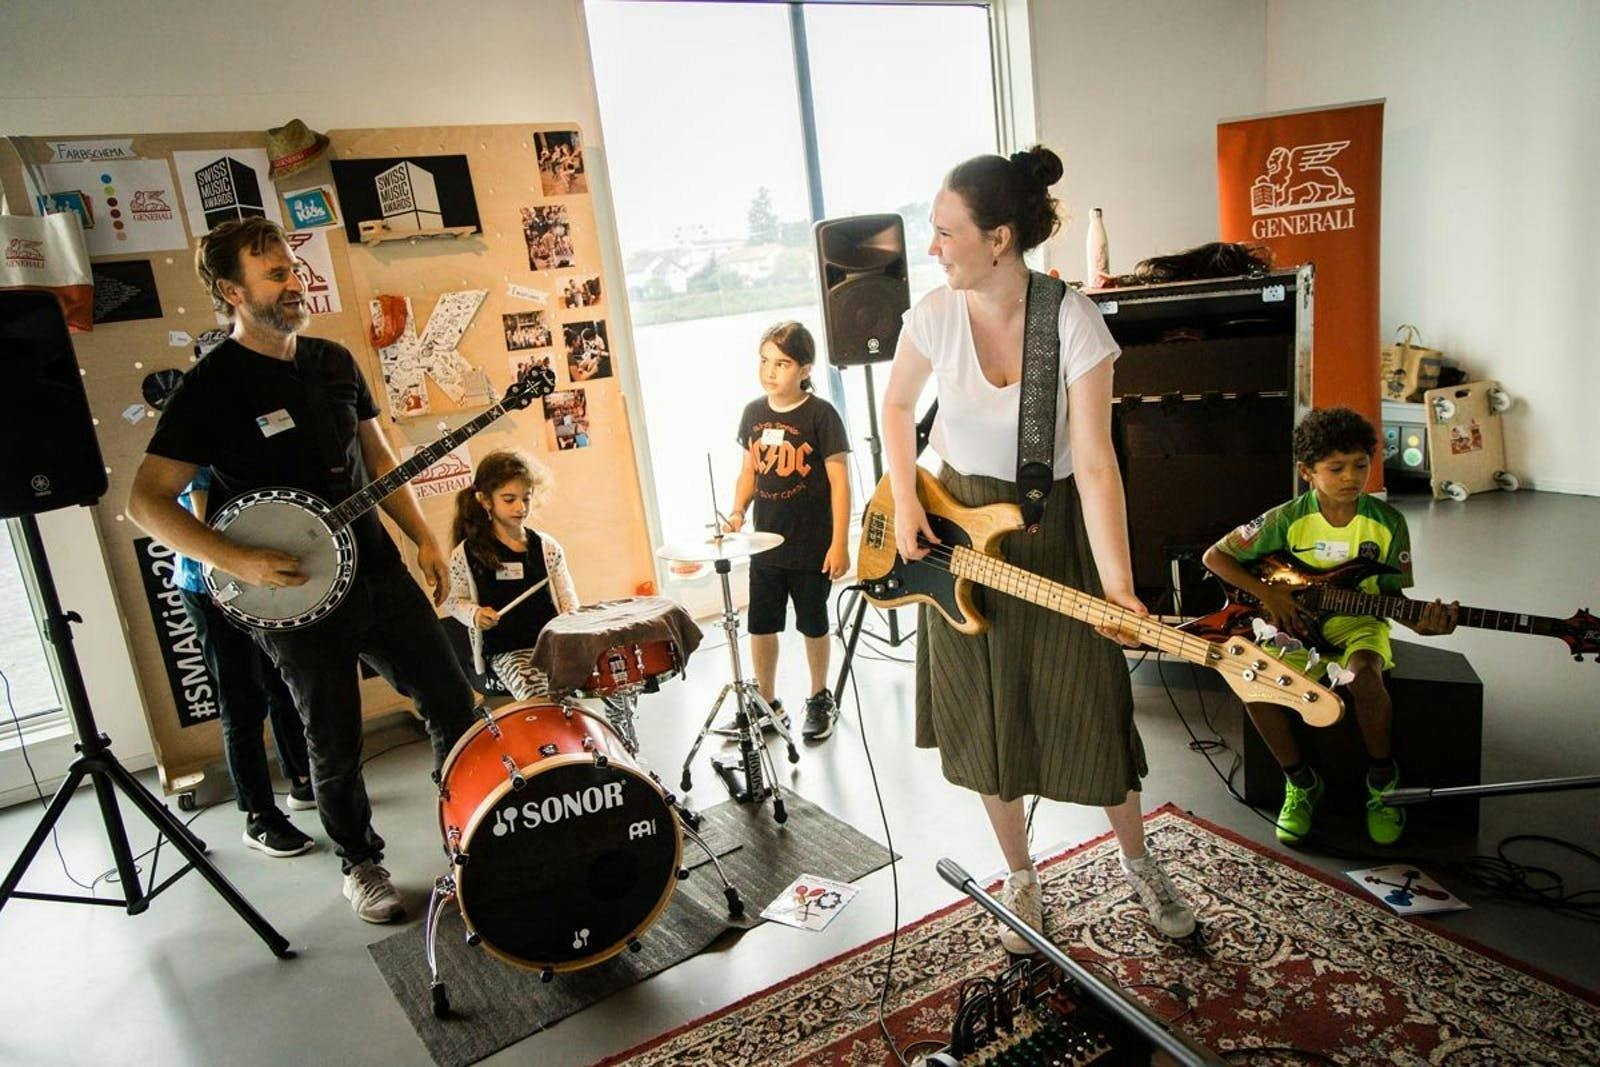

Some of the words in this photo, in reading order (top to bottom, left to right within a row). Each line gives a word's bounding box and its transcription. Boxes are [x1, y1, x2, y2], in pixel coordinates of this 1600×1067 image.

[196, 162, 228, 185] SWISS
[377, 166, 406, 190] SWISS
[200, 178, 231, 198] MUSIC
[380, 182, 409, 203] MUSIC
[204, 192, 234, 210] AWARDS
[383, 197, 412, 213] AWARDS
[132, 212, 173, 222] GENERALI
[1252, 208, 1355, 240] GENERALI
[522, 782, 624, 829] SONOR
